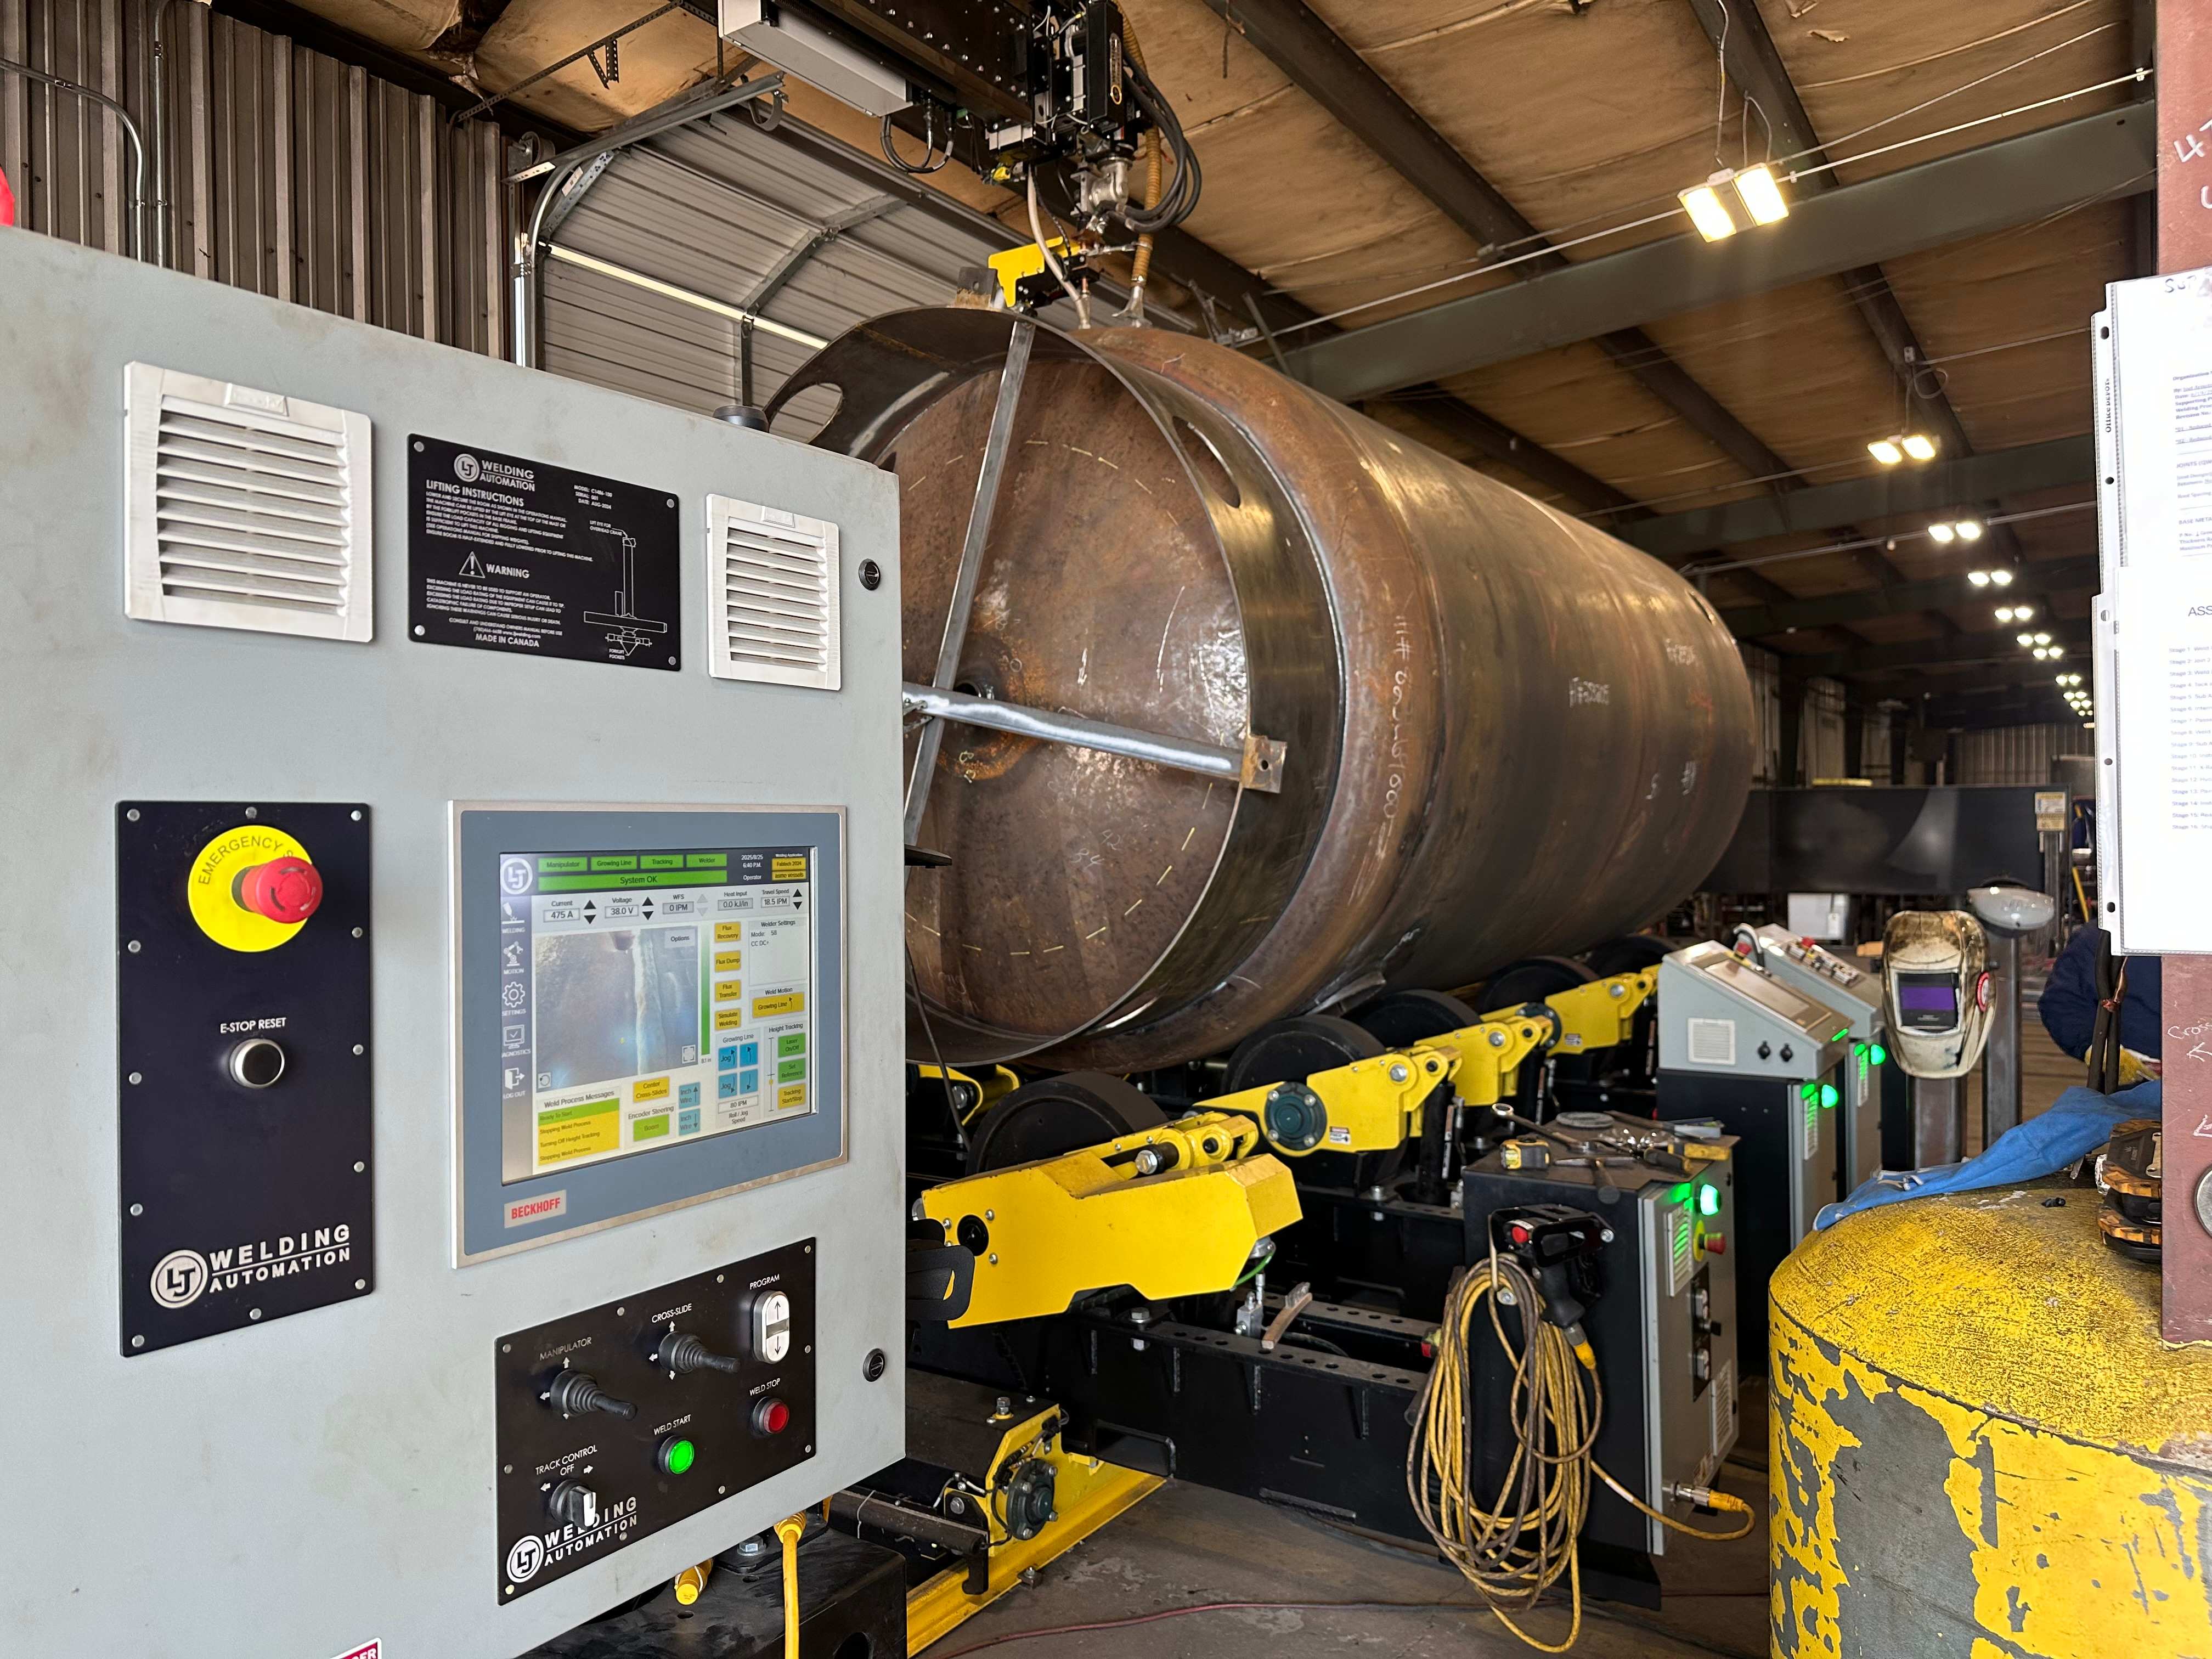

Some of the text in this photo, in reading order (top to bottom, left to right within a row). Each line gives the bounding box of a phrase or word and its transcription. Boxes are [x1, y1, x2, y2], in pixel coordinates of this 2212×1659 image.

[482, 460, 535, 479] WELDING
[479, 473, 535, 492] AUTOMATION
[426, 479, 524, 506] LIFTING INSTRUCTIONS
[486, 563, 530, 578] WARNING
[475, 633, 497, 642] MADE
[507, 637, 539, 647] CANADA
[198, 836, 283, 885] EMERGENCY
[620, 877, 645, 885] System
[220, 1017, 286, 1034] E-STOP RESET
[561, 1096, 584, 1105] Process
[585, 1091, 614, 1101] Messages
[636, 1089, 667, 1098] Cross-Slides
[628, 1106, 674, 1119] Encoder Steering
[511, 1197, 560, 1220] BECKHOFF
[209, 1224, 350, 1271] WELDING
[209, 1248, 351, 1293] AUTOMATION
[749, 1273, 780, 1290] PROGRAM
[652, 1303, 692, 1323] CROSS-SLIDE
[539, 1336, 592, 1361] MANIPULATOR
[749, 1378, 781, 1396] WELD STOP
[654, 1414, 691, 1435] WELD START
[535, 1444, 597, 1475] TRACK CONTROL
[560, 1464, 574, 1476] OFF
[544, 1497, 637, 1548] WEING
[544, 1515, 637, 1566] AUTOMATION
